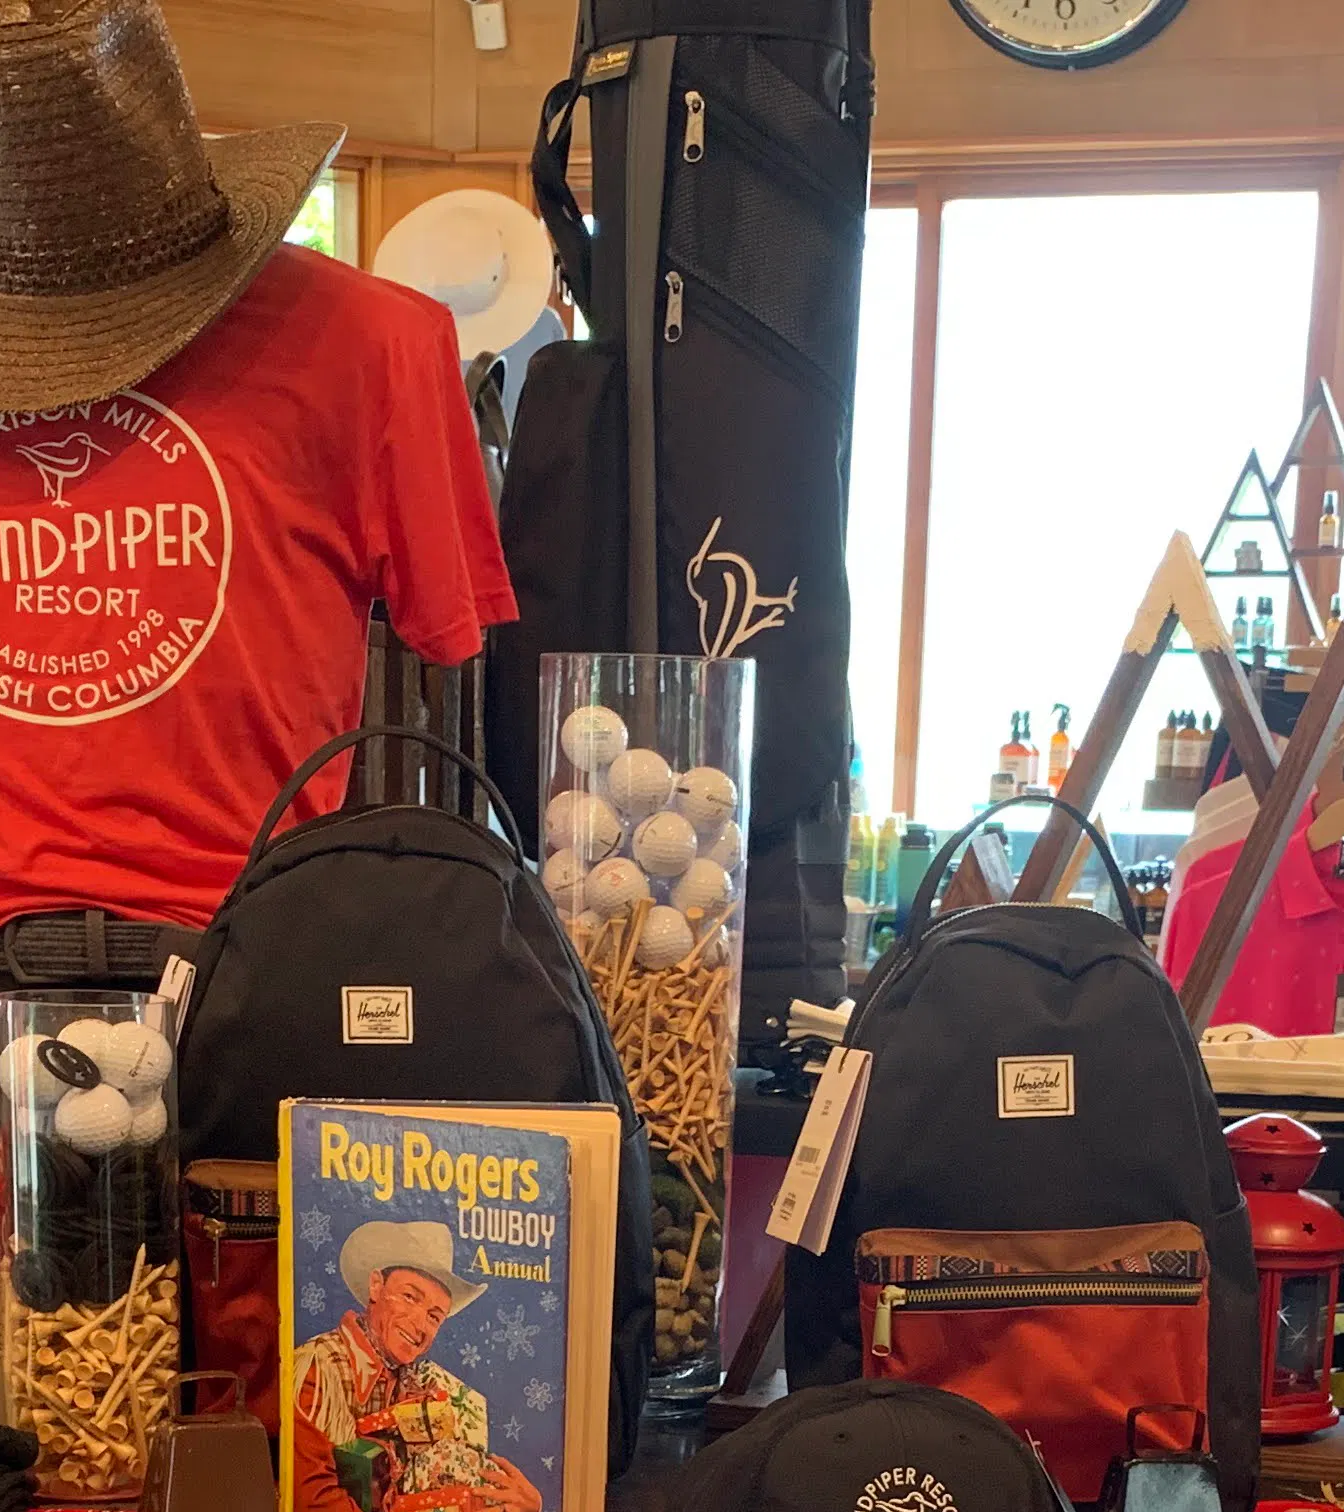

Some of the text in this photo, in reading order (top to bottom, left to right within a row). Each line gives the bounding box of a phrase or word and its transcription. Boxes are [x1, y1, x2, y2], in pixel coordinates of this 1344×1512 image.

[102, 402, 187, 465] MILLS
[15, 583, 141, 618] RESORT
[116, 608, 165, 657] 1998
[46, 615, 204, 713] COLUMBIA
[357, 1001, 401, 1022] Herschel
[1013, 1071, 1060, 1094] Herschel
[320, 1121, 540, 1209] Roy Rogers
[457, 1205, 556, 1250] COWBOY
[466, 1244, 553, 1283] Annual
